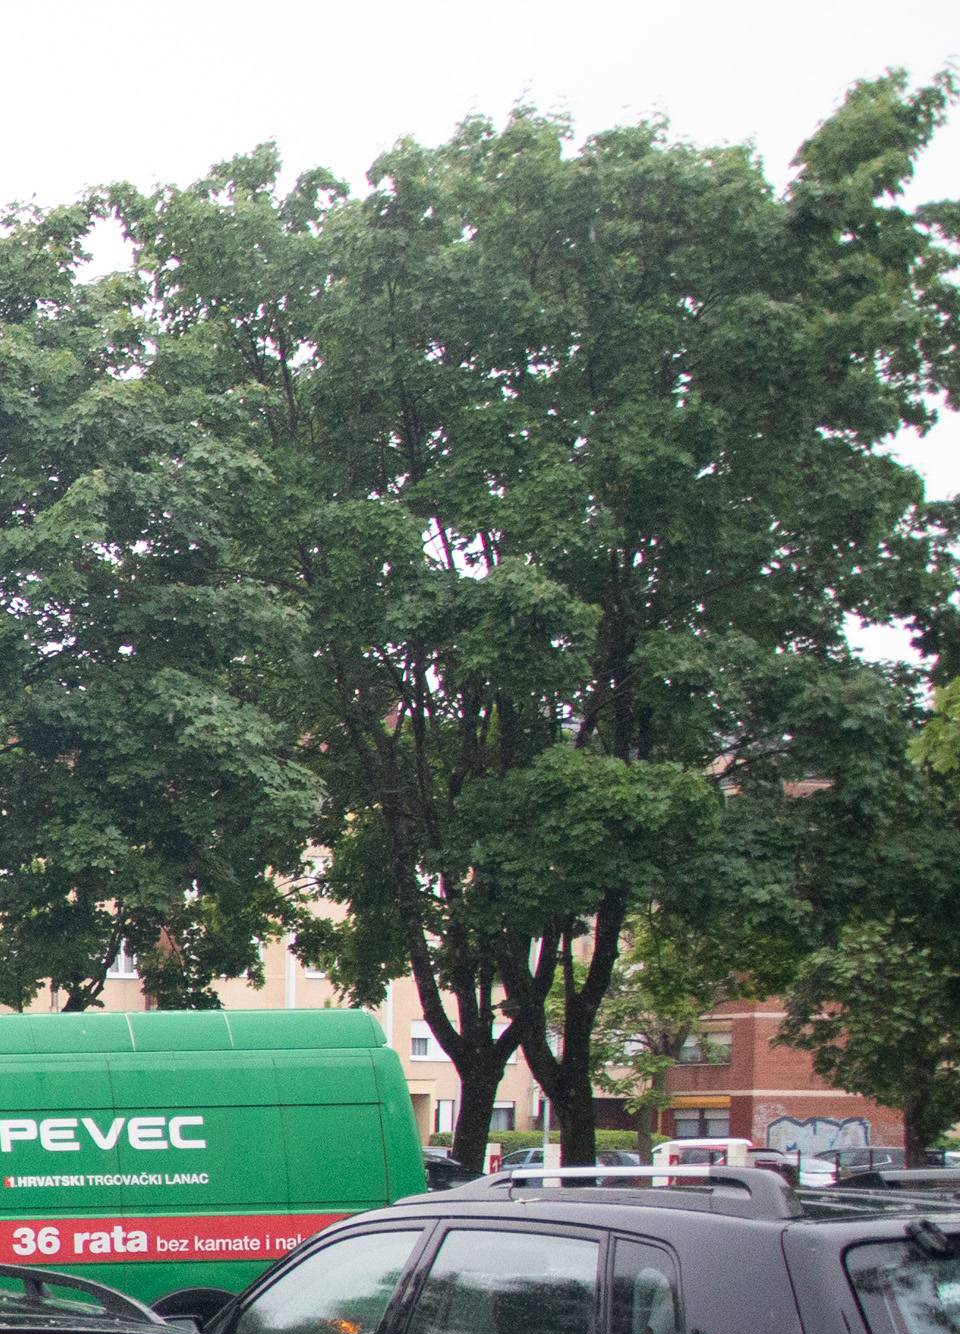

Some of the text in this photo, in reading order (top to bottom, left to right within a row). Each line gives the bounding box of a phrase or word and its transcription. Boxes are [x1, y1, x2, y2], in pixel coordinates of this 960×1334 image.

[86, 1172, 162, 1187] TRGOVAČKI
[165, 1172, 209, 1185] LANAC
[12, 1227, 60, 1256] 36
[73, 1225, 148, 1255] rata
[156, 1235, 190, 1252] bez
[194, 1235, 260, 1251] kamate
[265, 1234, 270, 1250] i
